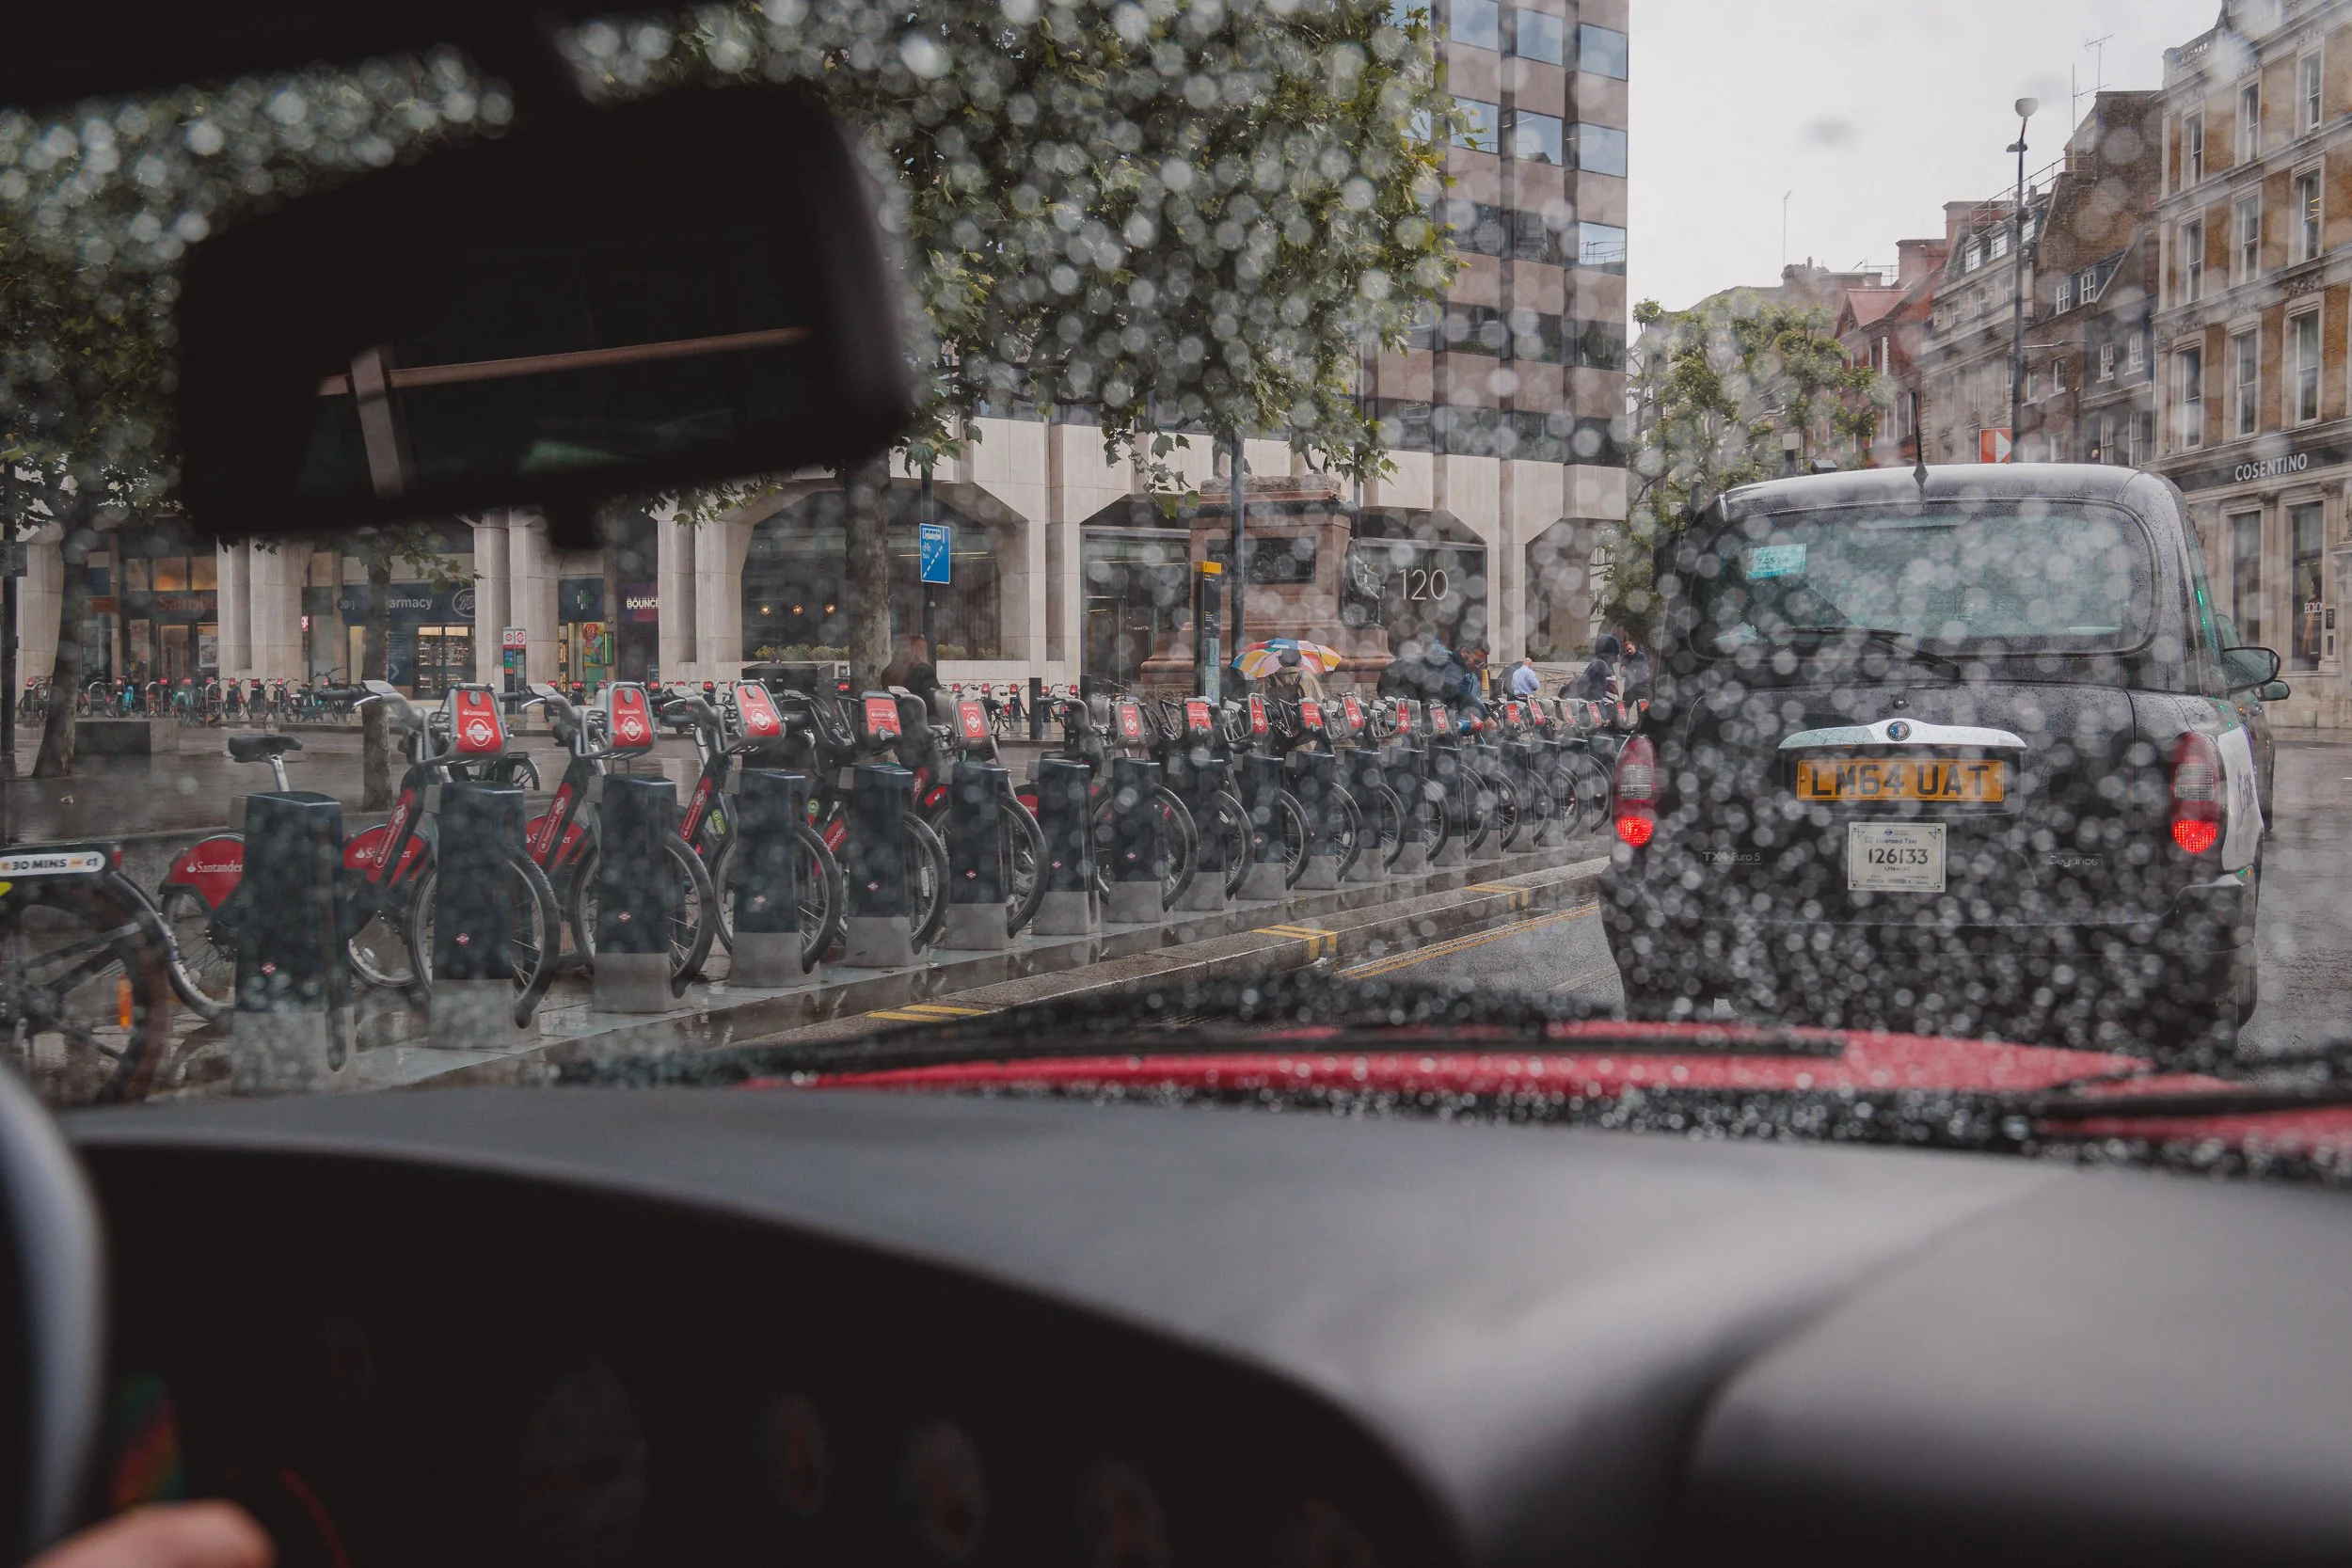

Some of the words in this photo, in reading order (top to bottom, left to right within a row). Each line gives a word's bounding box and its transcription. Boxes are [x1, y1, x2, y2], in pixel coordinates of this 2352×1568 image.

[2234, 452, 2308, 482] COSENTINO
[1398, 569, 1448, 600] 120
[386, 598, 433, 610] armacy
[1811, 764, 1904, 796] LM64
[1917, 765, 1989, 796] UAT
[1702, 851, 1728, 862] TX4
[1731, 853, 1753, 862] Euro
[1754, 853, 1761, 862] 5
[1868, 848, 1929, 864] 126133
[11, 862, 29, 870] 30
[31, 859, 67, 869] MINS
[196, 860, 244, 873] Santander
